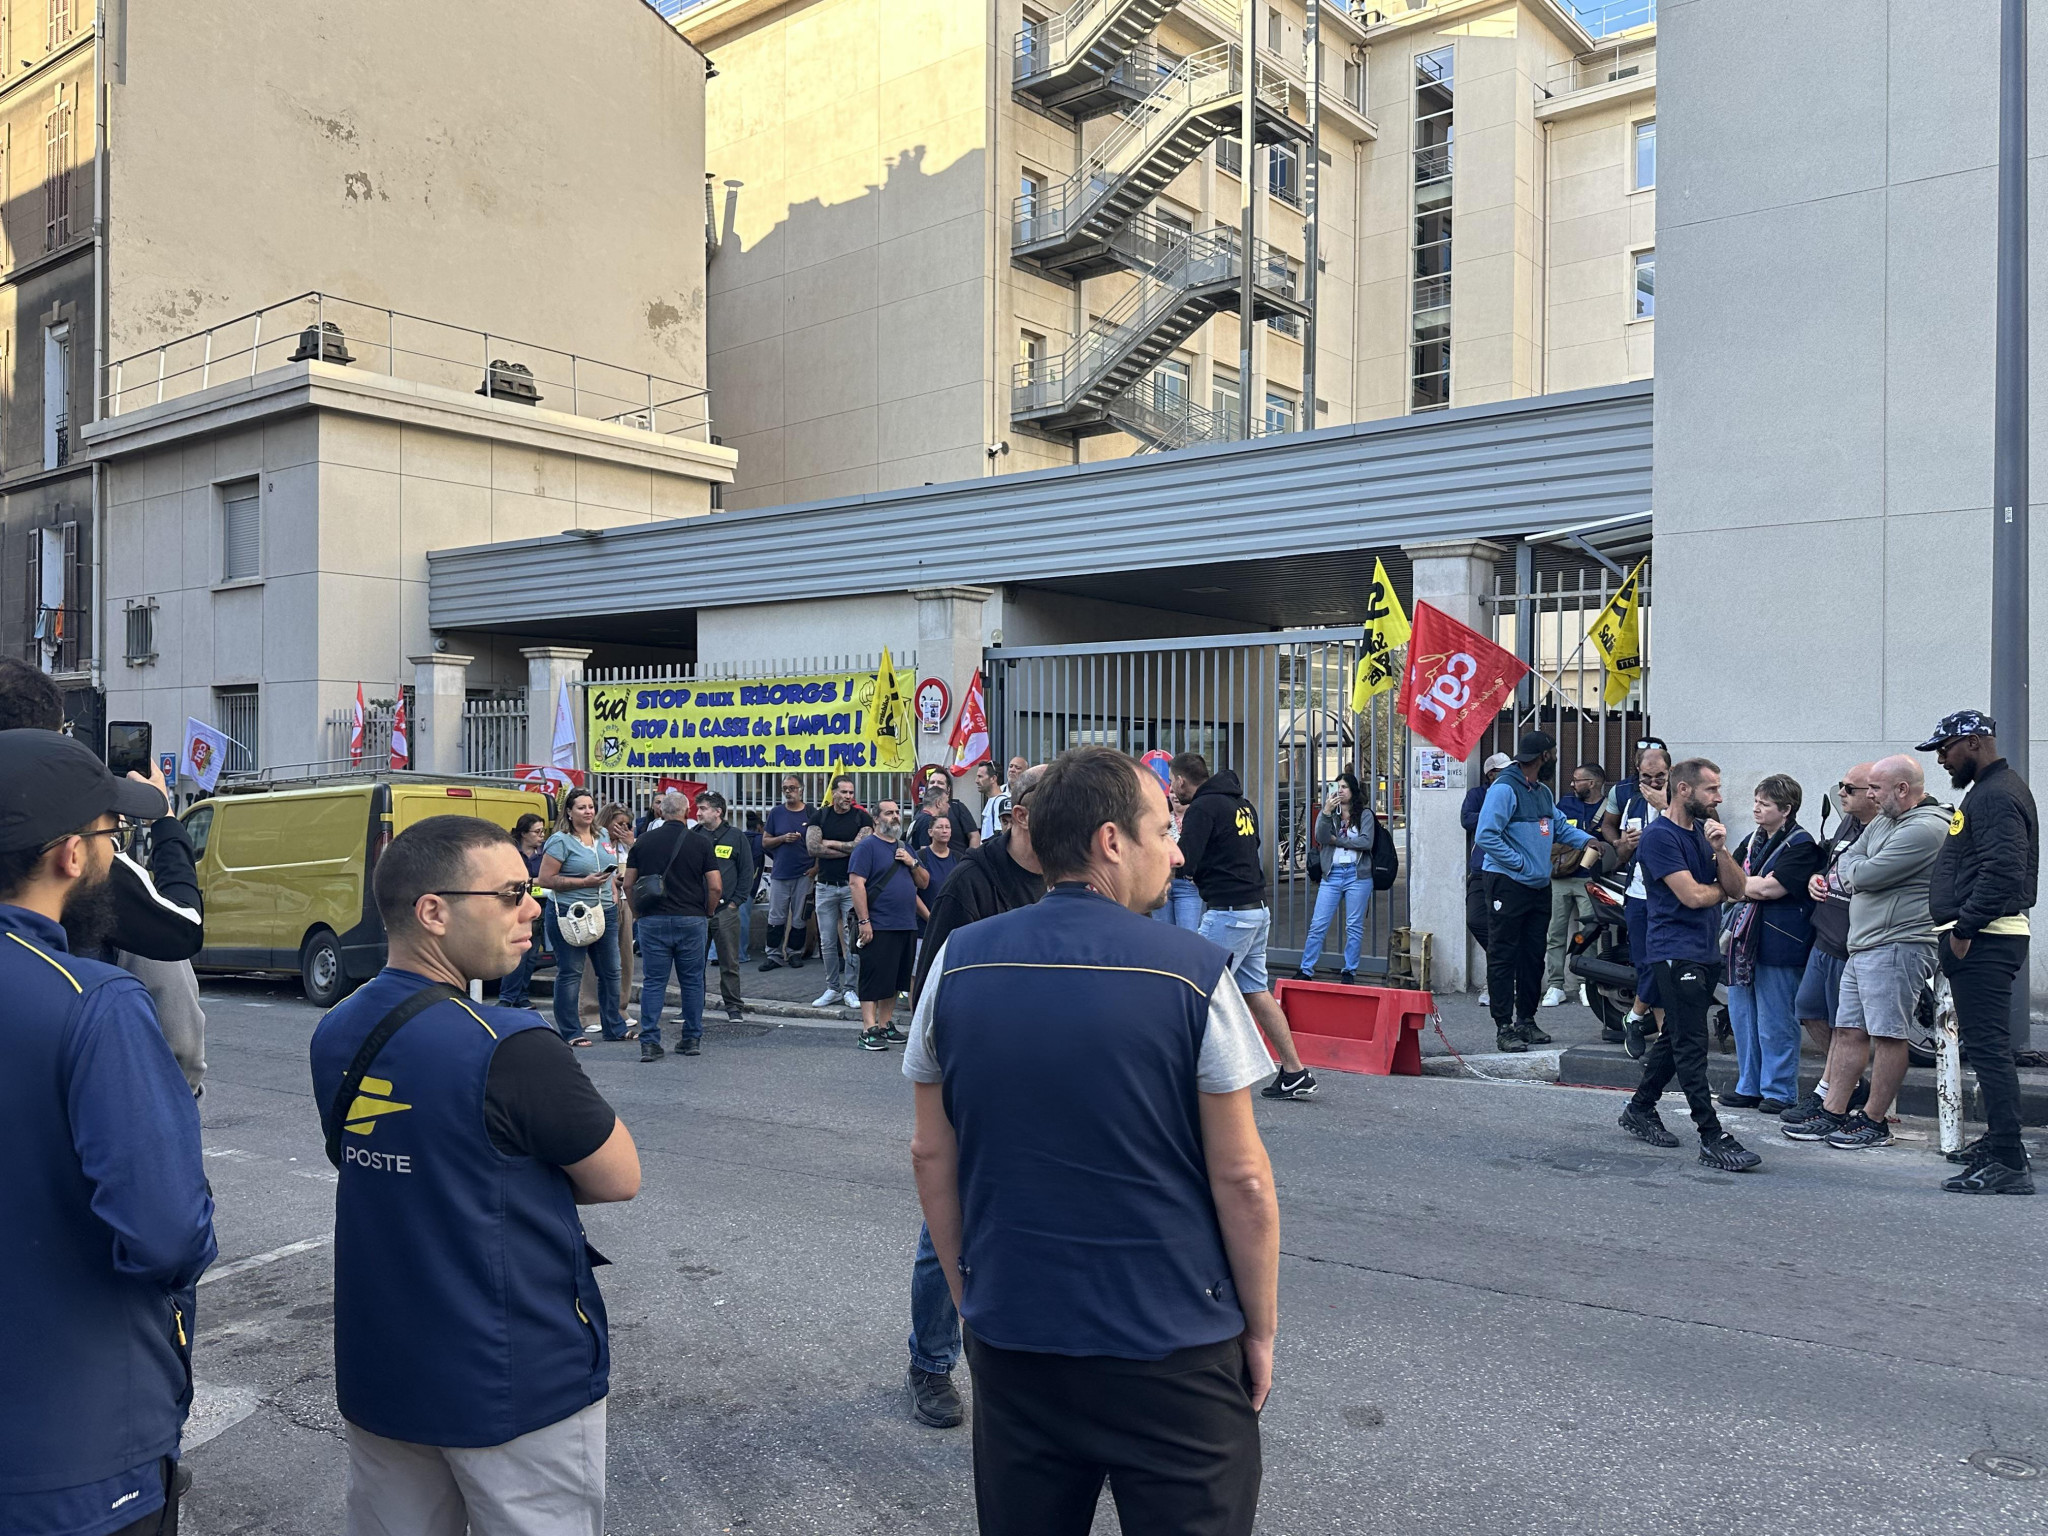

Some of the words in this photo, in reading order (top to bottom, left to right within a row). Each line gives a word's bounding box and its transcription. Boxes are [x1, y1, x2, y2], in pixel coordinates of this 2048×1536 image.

[594, 690, 627, 722] Sud
[636, 689, 691, 709] STOP
[695, 691, 734, 707] aux
[631, 719, 668, 739] STOP
[669, 718, 679, 738] à
[682, 718, 696, 738] la
[699, 717, 750, 738] CASSE
[752, 716, 772, 736] de
[775, 711, 850, 736] L'EMPLOI
[627, 747, 645, 768] Au
[648, 747, 691, 768] service
[693, 747, 711, 767] du
[805, 743, 825, 767] du
[829, 742, 866, 767] FRIC
[346, 1146, 412, 1173] POSTE
